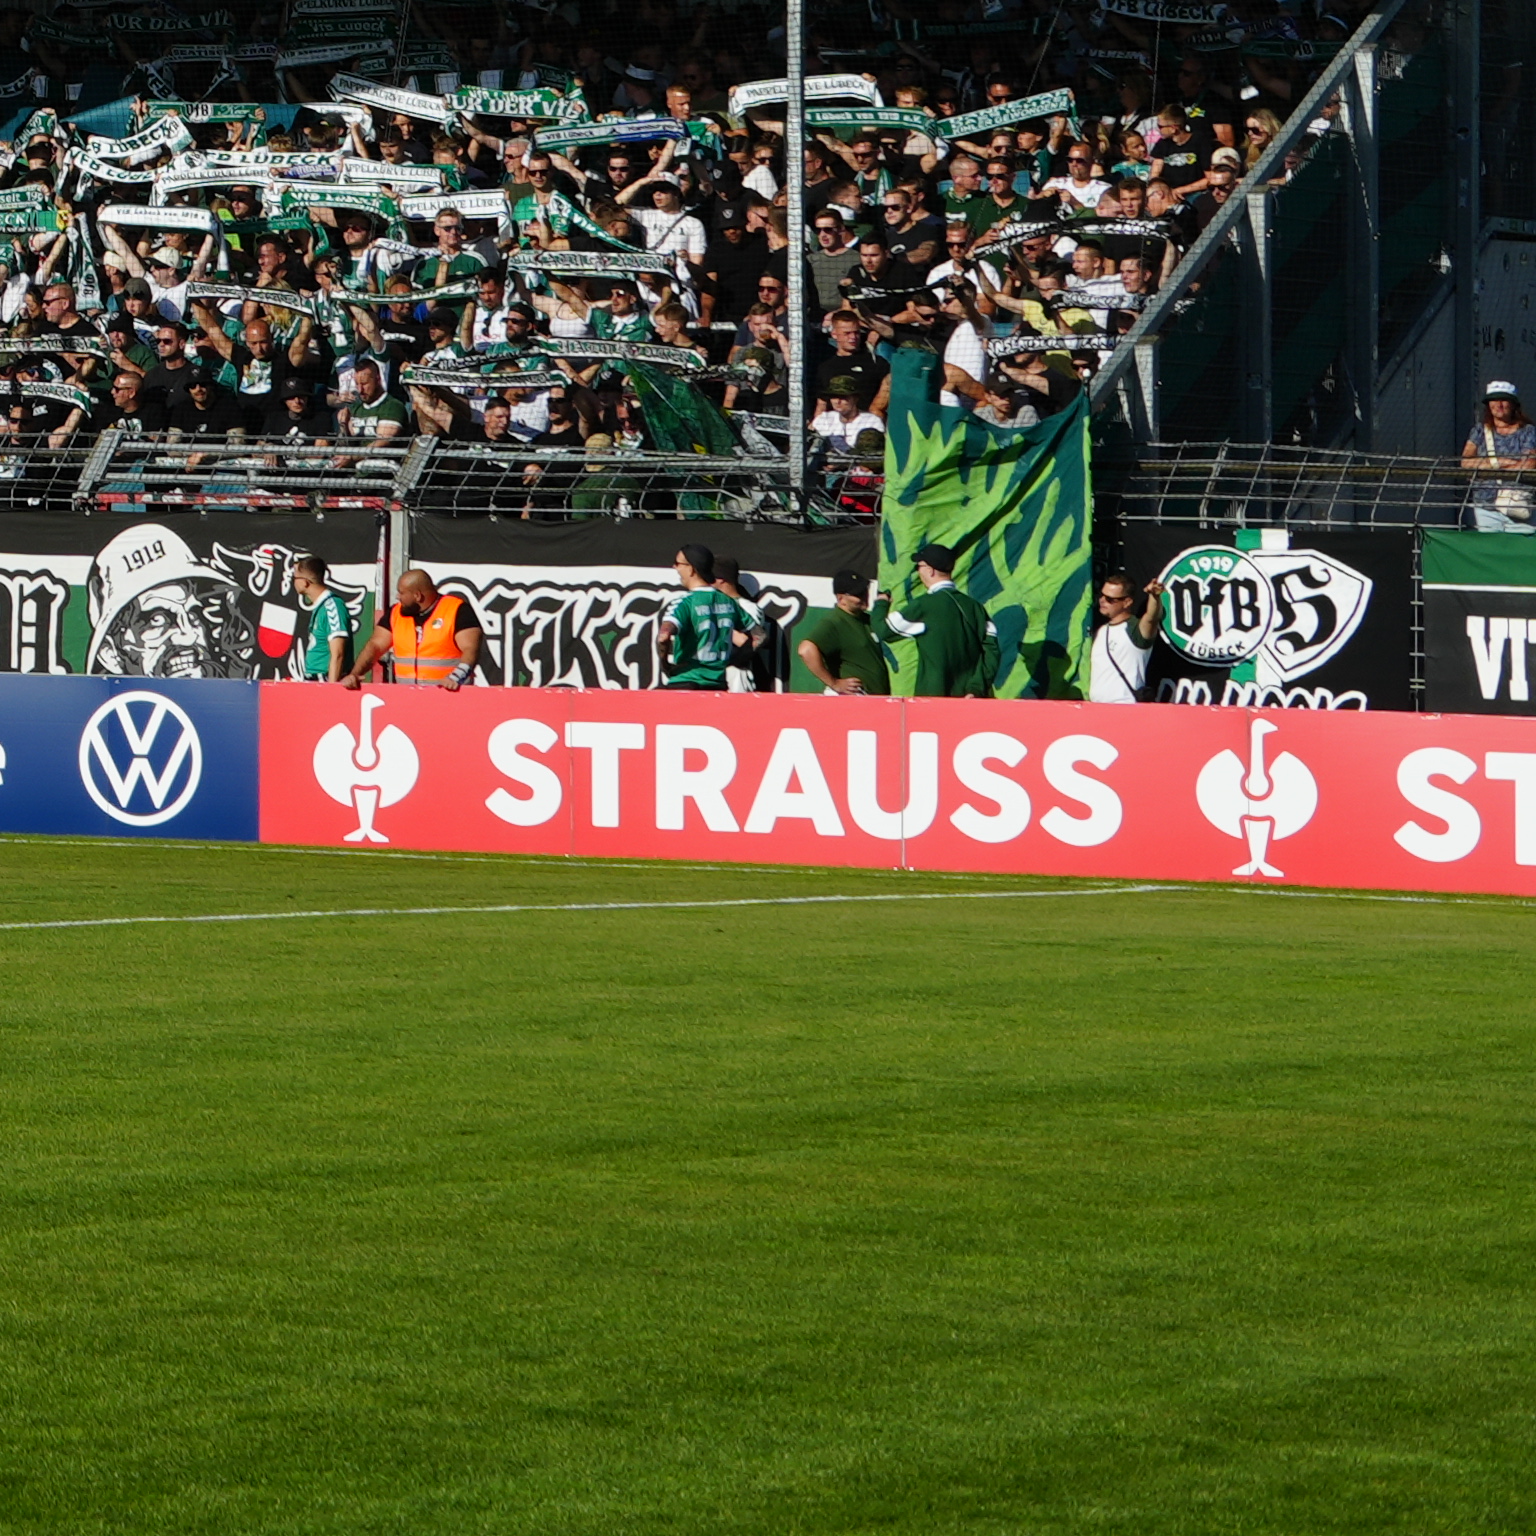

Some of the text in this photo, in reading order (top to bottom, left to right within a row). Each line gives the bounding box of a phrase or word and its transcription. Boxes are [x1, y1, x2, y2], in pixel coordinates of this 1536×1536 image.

[1143, 1, 1215, 21] LÜBECK
[483, 96, 535, 115] DER
[104, 120, 171, 155] LÜBECK
[241, 153, 333, 166] LÜBECK
[122, 540, 167, 573] 1919
[1188, 556, 1232, 574] 1919
[1186, 638, 1247, 662] LÜBECK
[1466, 615, 1536, 702] VI
[484, 718, 1123, 847] STRAUSS
